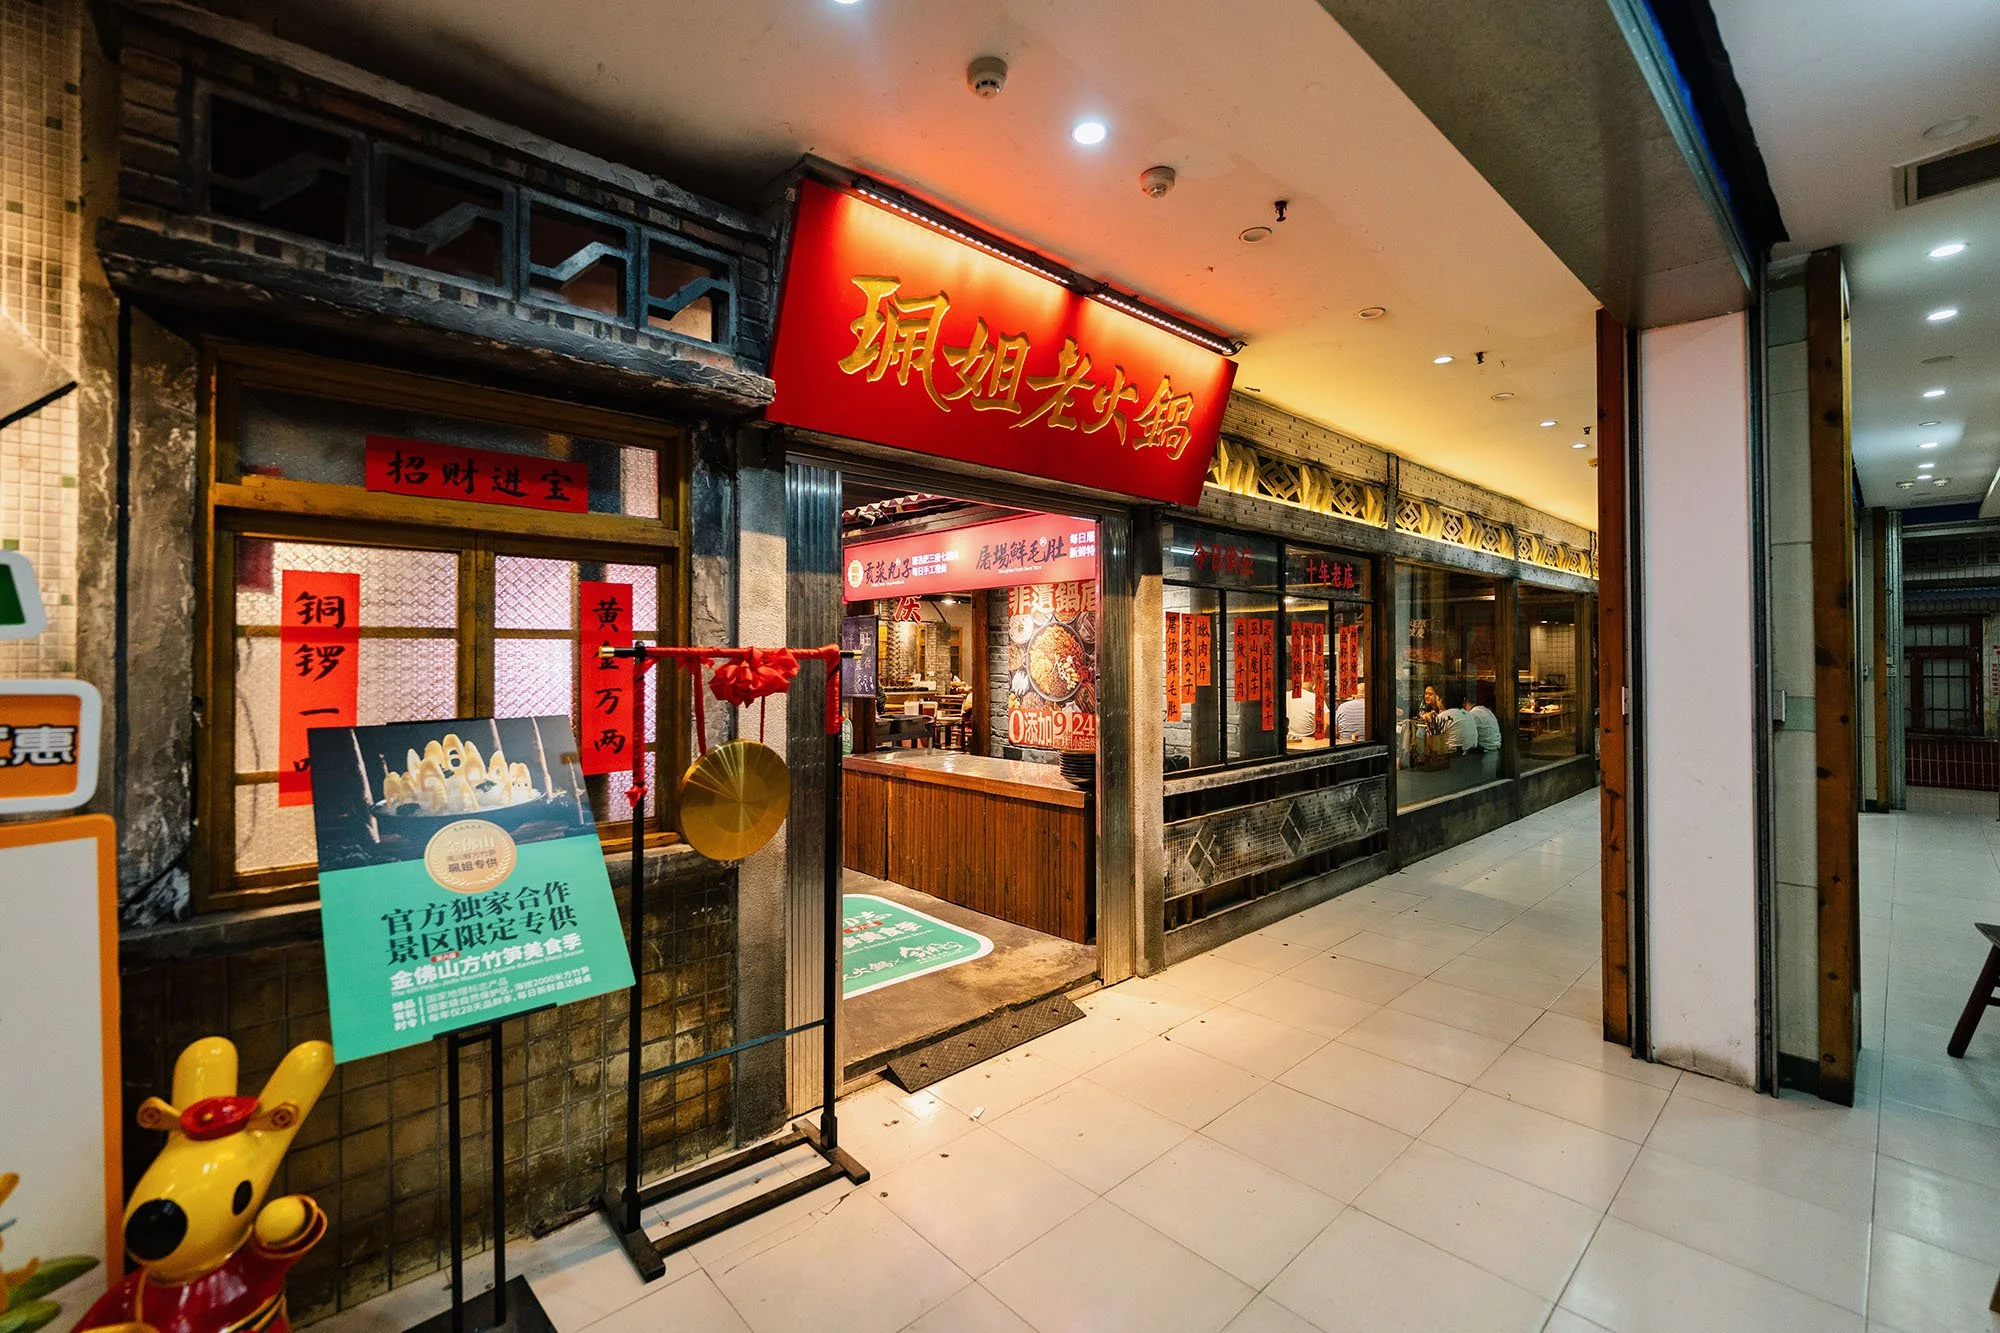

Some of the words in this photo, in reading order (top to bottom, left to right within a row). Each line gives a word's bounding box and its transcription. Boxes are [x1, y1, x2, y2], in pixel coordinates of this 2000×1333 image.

[386, 450, 573, 501] 招财进宝
[1306, 559, 1354, 588] 十年老店
[294, 591, 346, 774] 铜锣一
[592, 597, 626, 756] 黄金万两
[381, 881, 571, 935] 官方独家合作
[387, 905, 578, 966] 景区限定专供
[390, 932, 582, 991] 金佛山方竹笋美食季
